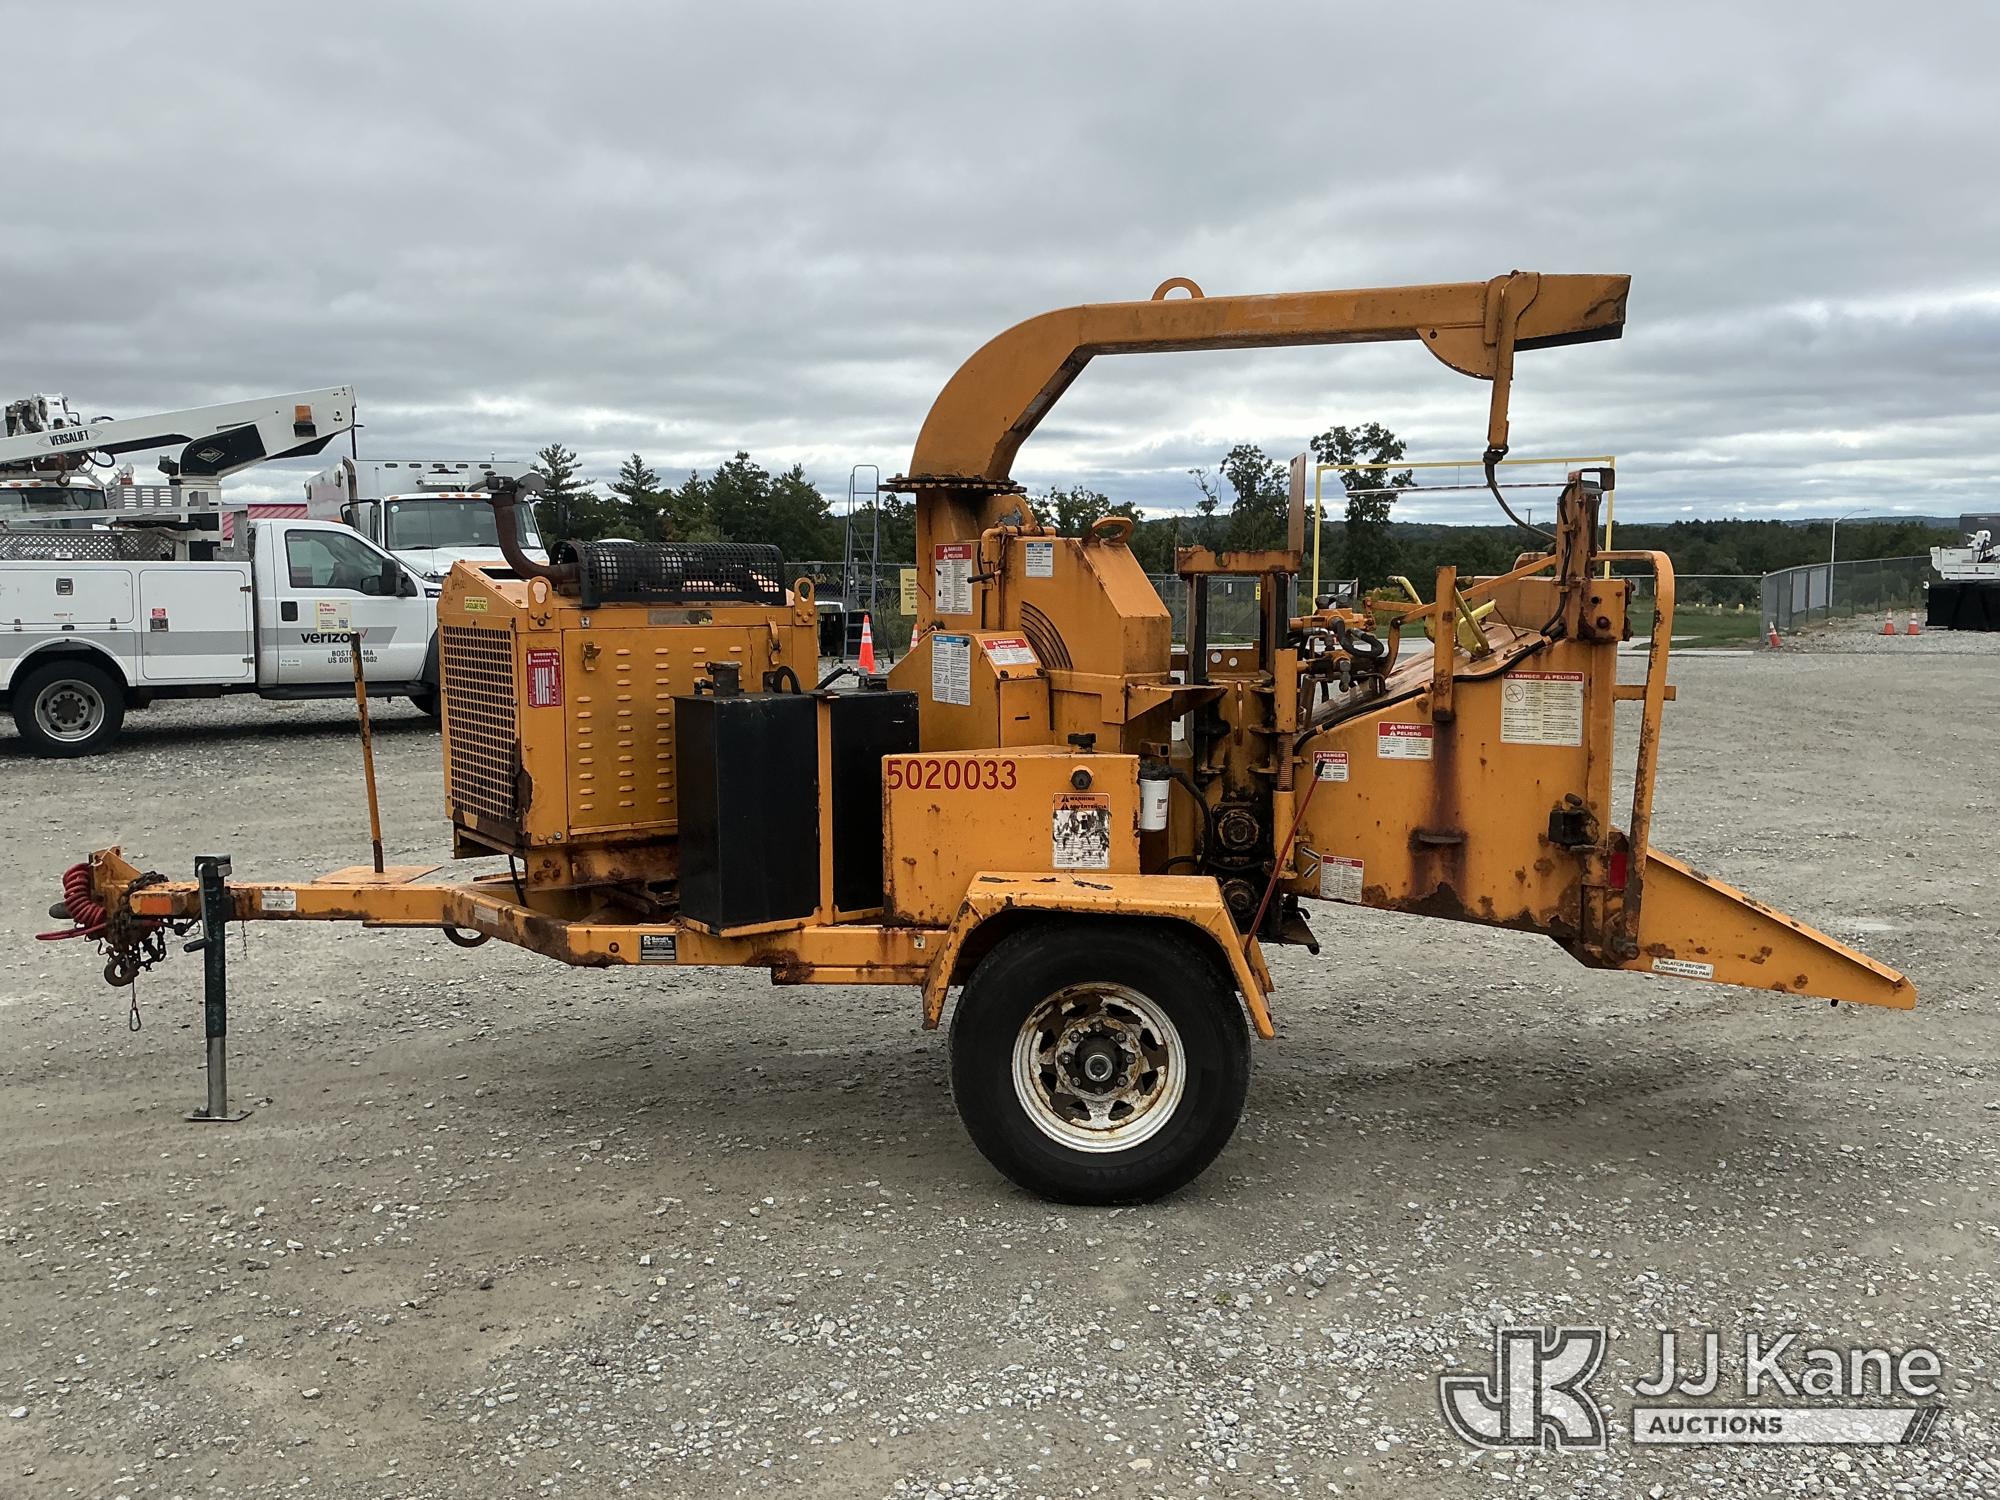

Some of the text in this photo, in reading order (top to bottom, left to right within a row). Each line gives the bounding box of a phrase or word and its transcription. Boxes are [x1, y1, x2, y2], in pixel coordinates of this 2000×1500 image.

[49, 430, 89, 446] VERSALIFT
[301, 632, 351, 644] verizo
[339, 656, 352, 664] DOT
[887, 759, 1017, 790] 5020033
[1654, 964, 1678, 972] CLOSING
